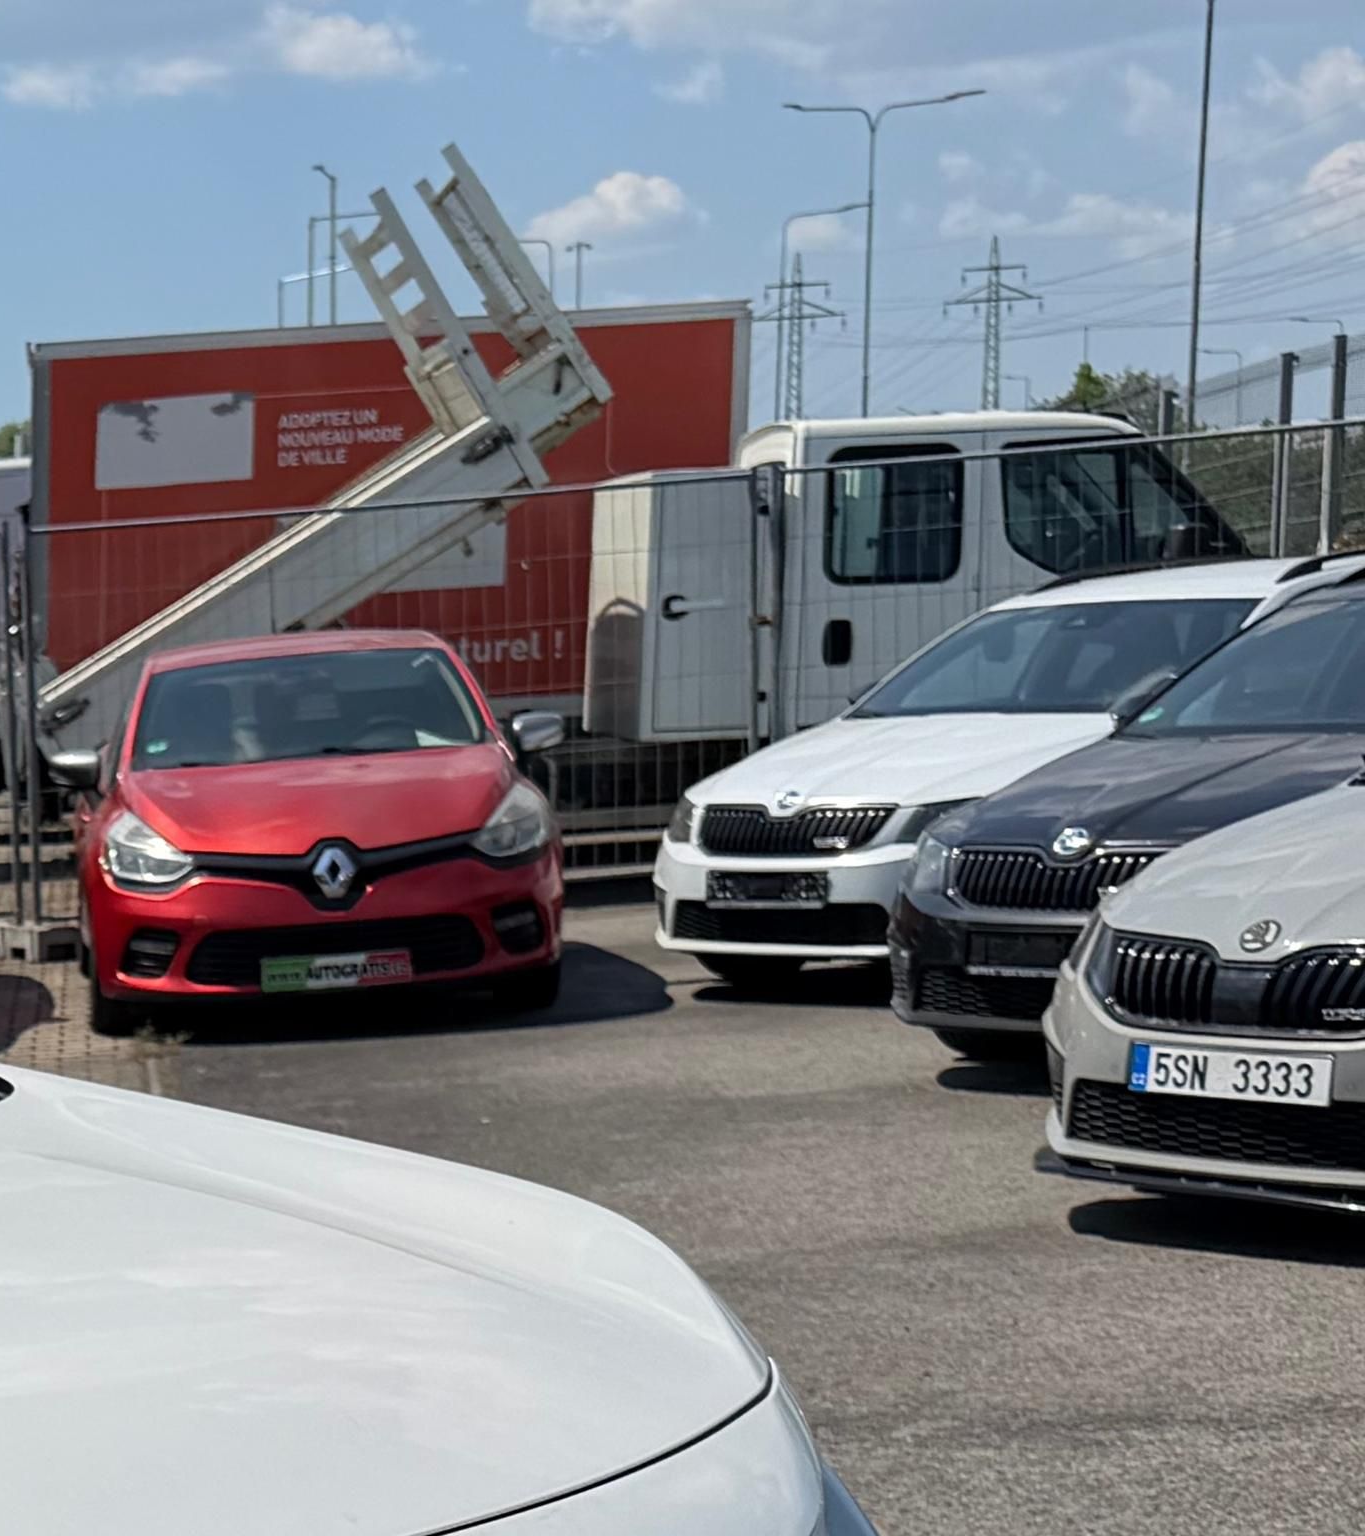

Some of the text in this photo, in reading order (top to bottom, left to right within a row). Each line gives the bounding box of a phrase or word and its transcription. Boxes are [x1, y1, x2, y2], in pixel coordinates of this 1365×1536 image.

[278, 408, 378, 429] ADOPTEZ UN
[278, 425, 404, 448] NOUVEAU MODE
[277, 447, 348, 467] DE VILLE
[451, 630, 542, 664] turel
[1154, 1052, 1314, 1098] 5SN 3333
